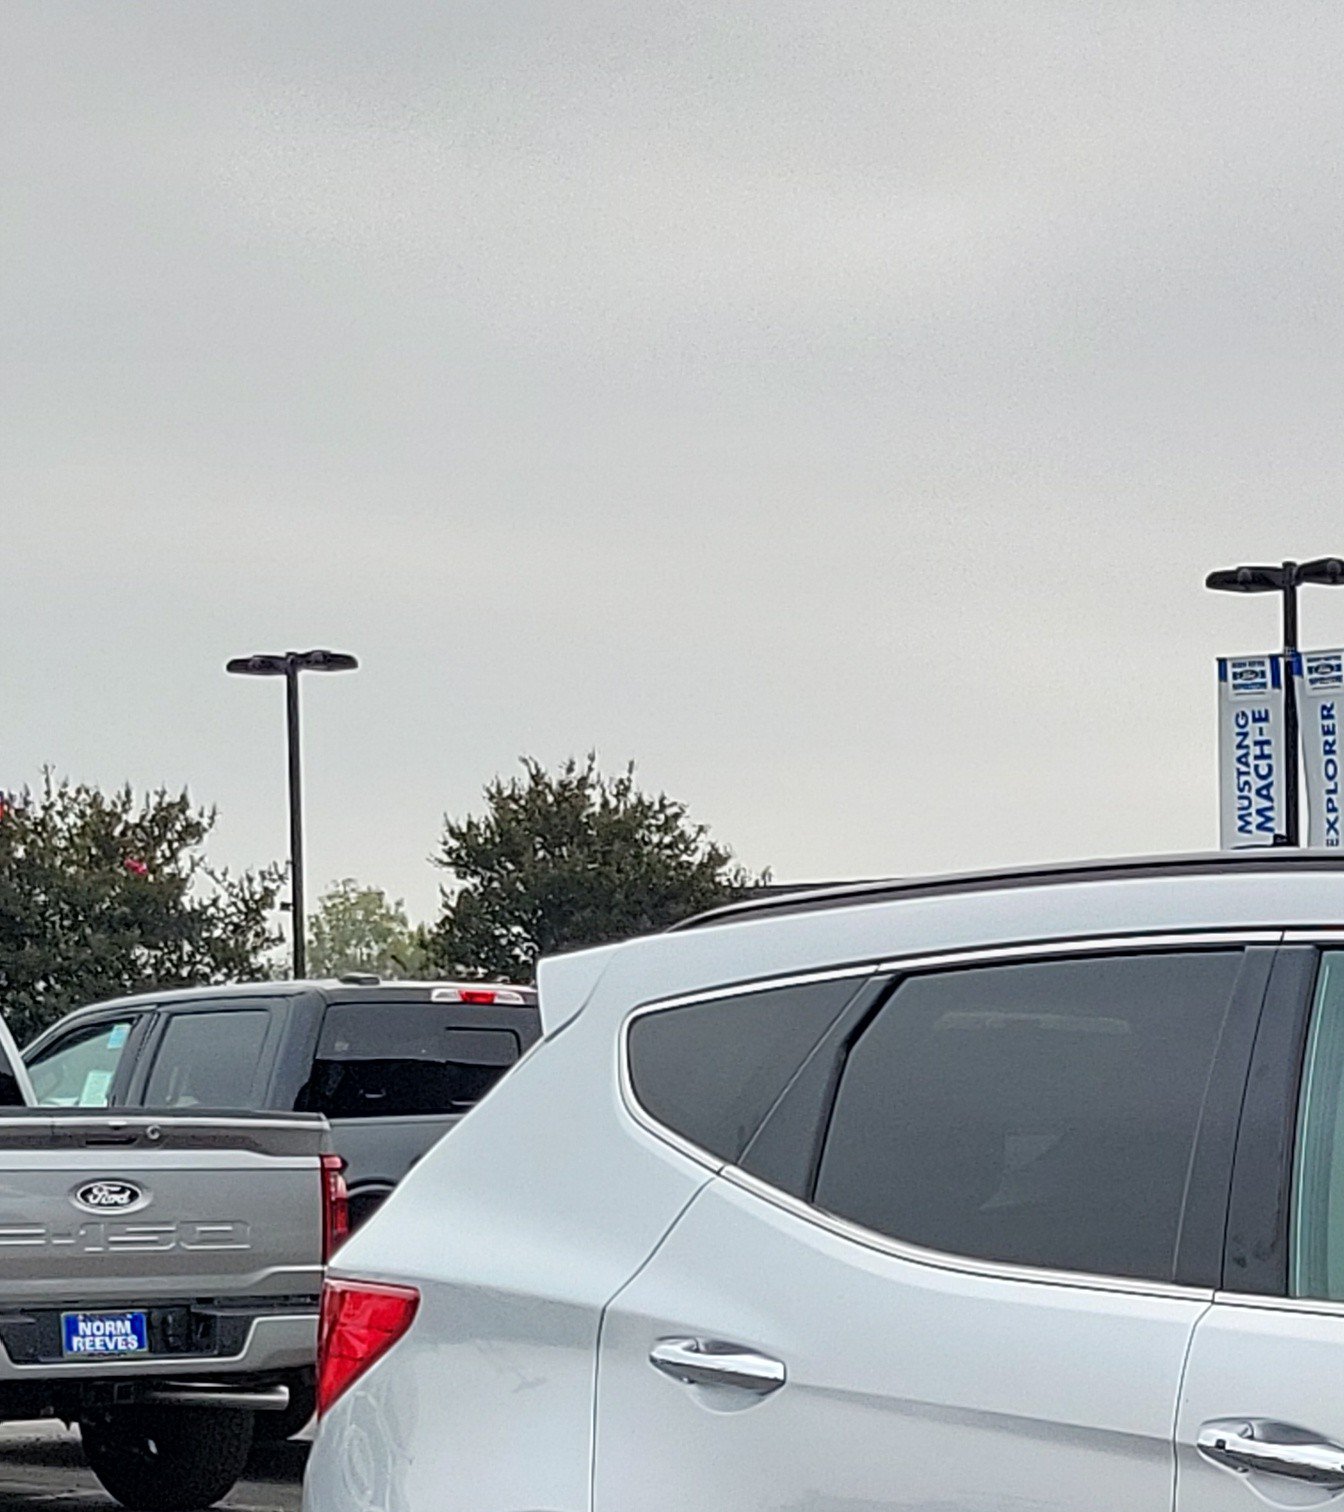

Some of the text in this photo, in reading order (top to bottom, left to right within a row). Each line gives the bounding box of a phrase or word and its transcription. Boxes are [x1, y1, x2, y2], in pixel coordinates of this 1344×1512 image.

[1235, 710, 1253, 834] MUSTANG
[1251, 708, 1276, 833] MACH-E
[1320, 702, 1339, 847] EXPLORER
[71, 1335, 139, 1352] REEVES
[78, 1320, 132, 1336] NORM
